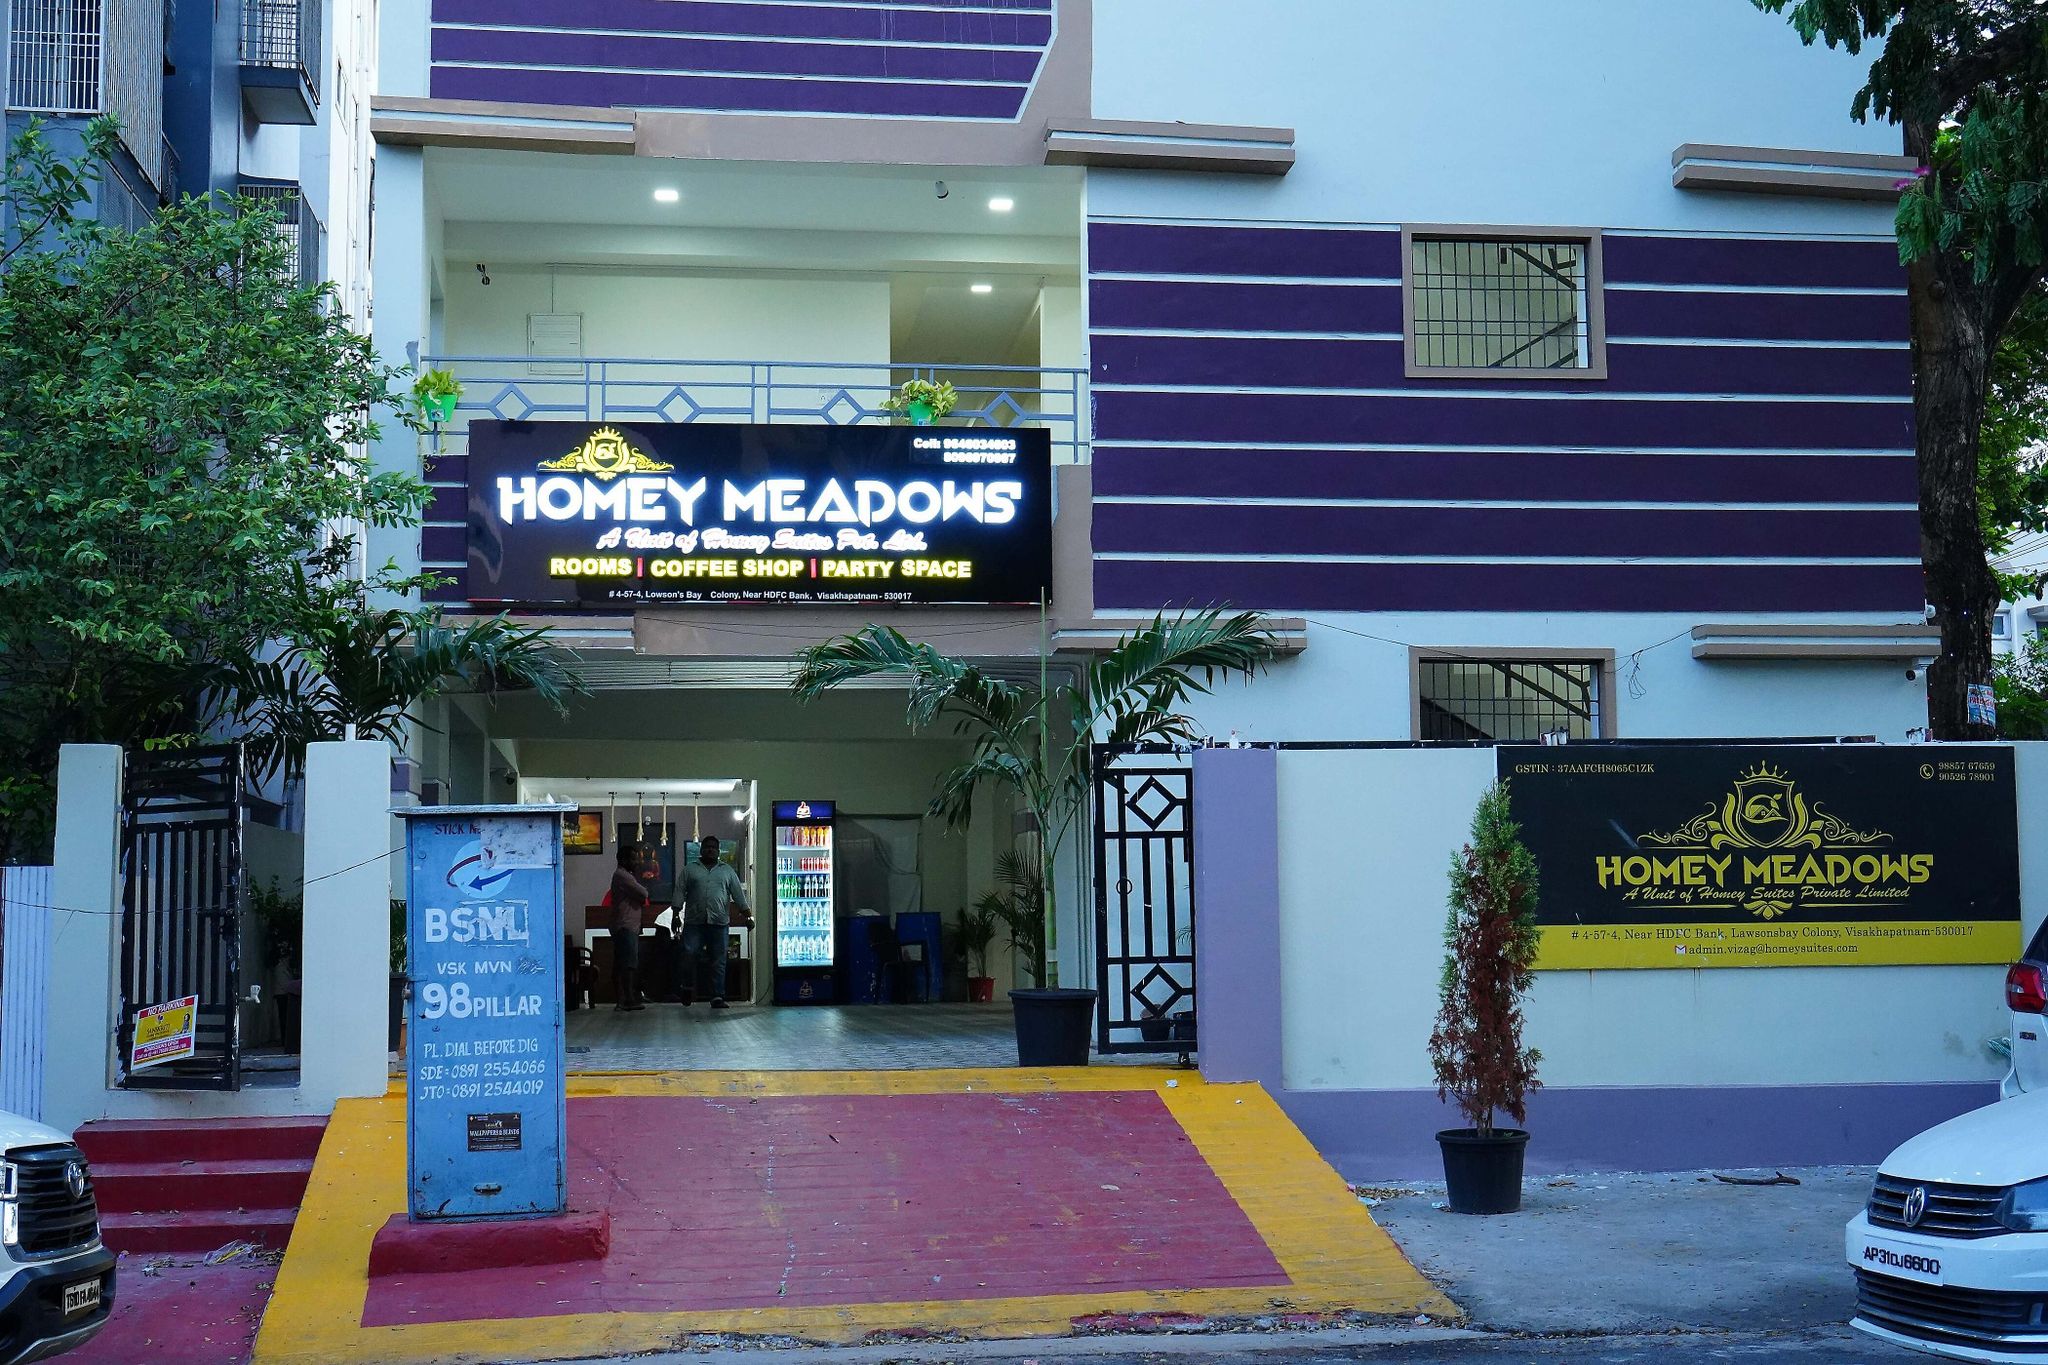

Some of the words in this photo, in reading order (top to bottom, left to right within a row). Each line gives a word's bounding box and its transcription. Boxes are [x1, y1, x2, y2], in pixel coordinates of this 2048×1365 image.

[497, 476, 706, 526] HOMEY
[723, 477, 1023, 527] MEADOWS
[596, 528, 622, 549] A
[626, 529, 673, 549] Unit
[674, 528, 698, 554] of
[701, 529, 772, 554] Homey
[772, 529, 834, 550] Suites
[550, 558, 633, 577] ROOMS
[650, 559, 738, 578] COFFEE
[742, 559, 804, 577] SHOP
[822, 560, 894, 578] PARTY
[900, 559, 972, 578] SPACE
[646, 591, 684, 600] Lowson's
[686, 592, 702, 600] Bay
[710, 592, 740, 601] Colony,
[742, 592, 762, 600] Near
[764, 592, 788, 600] HDFC
[789, 592, 813, 600] Bank,
[817, 592, 878, 600] Visakhapatnam
[884, 592, 912, 600] 530017
[1515, 764, 1549, 773] GSTIN
[1938, 762, 1965, 770] 98857
[1938, 773, 1966, 781] 90526
[1968, 773, 1995, 781] 78901
[434, 824, 464, 835] STICK
[1596, 854, 1732, 888] HOMEY
[1744, 853, 1934, 888] MEADOWS
[1622, 888, 1639, 900] A
[1641, 886, 1674, 900] Unit
[1680, 886, 1694, 903] of
[1698, 886, 1746, 902] Homey
[1750, 886, 1796, 900] Suites
[1800, 886, 1851, 900] Private
[1856, 886, 1910, 899] Limited
[425, 906, 528, 943] BSNL
[1572, 930, 1578, 939] #
[1582, 930, 1620, 940] 4-57-4,
[1624, 929, 1652, 939] Near
[1656, 928, 1691, 938] HDFC
[1696, 928, 1727, 940] Bank,
[1732, 928, 1798, 940] Lawsonsbay
[1802, 927, 1841, 938] Colony,
[1844, 926, 1974, 938] Visakhapatnam-530017
[1688, 943, 1858, 954] admin.vizag@homeysuites.com
[436, 962, 467, 975] VSK
[474, 961, 512, 974] MVN
[148, 1008, 157, 1016] NO
[158, 1000, 185, 1014] PARKING
[445, 1042, 472, 1058] DIAL
[474, 1040, 516, 1056] BEFORE
[518, 1038, 538, 1053] DIG
[483, 1060, 546, 1077] 2554066
[484, 1080, 544, 1096] 2544019
